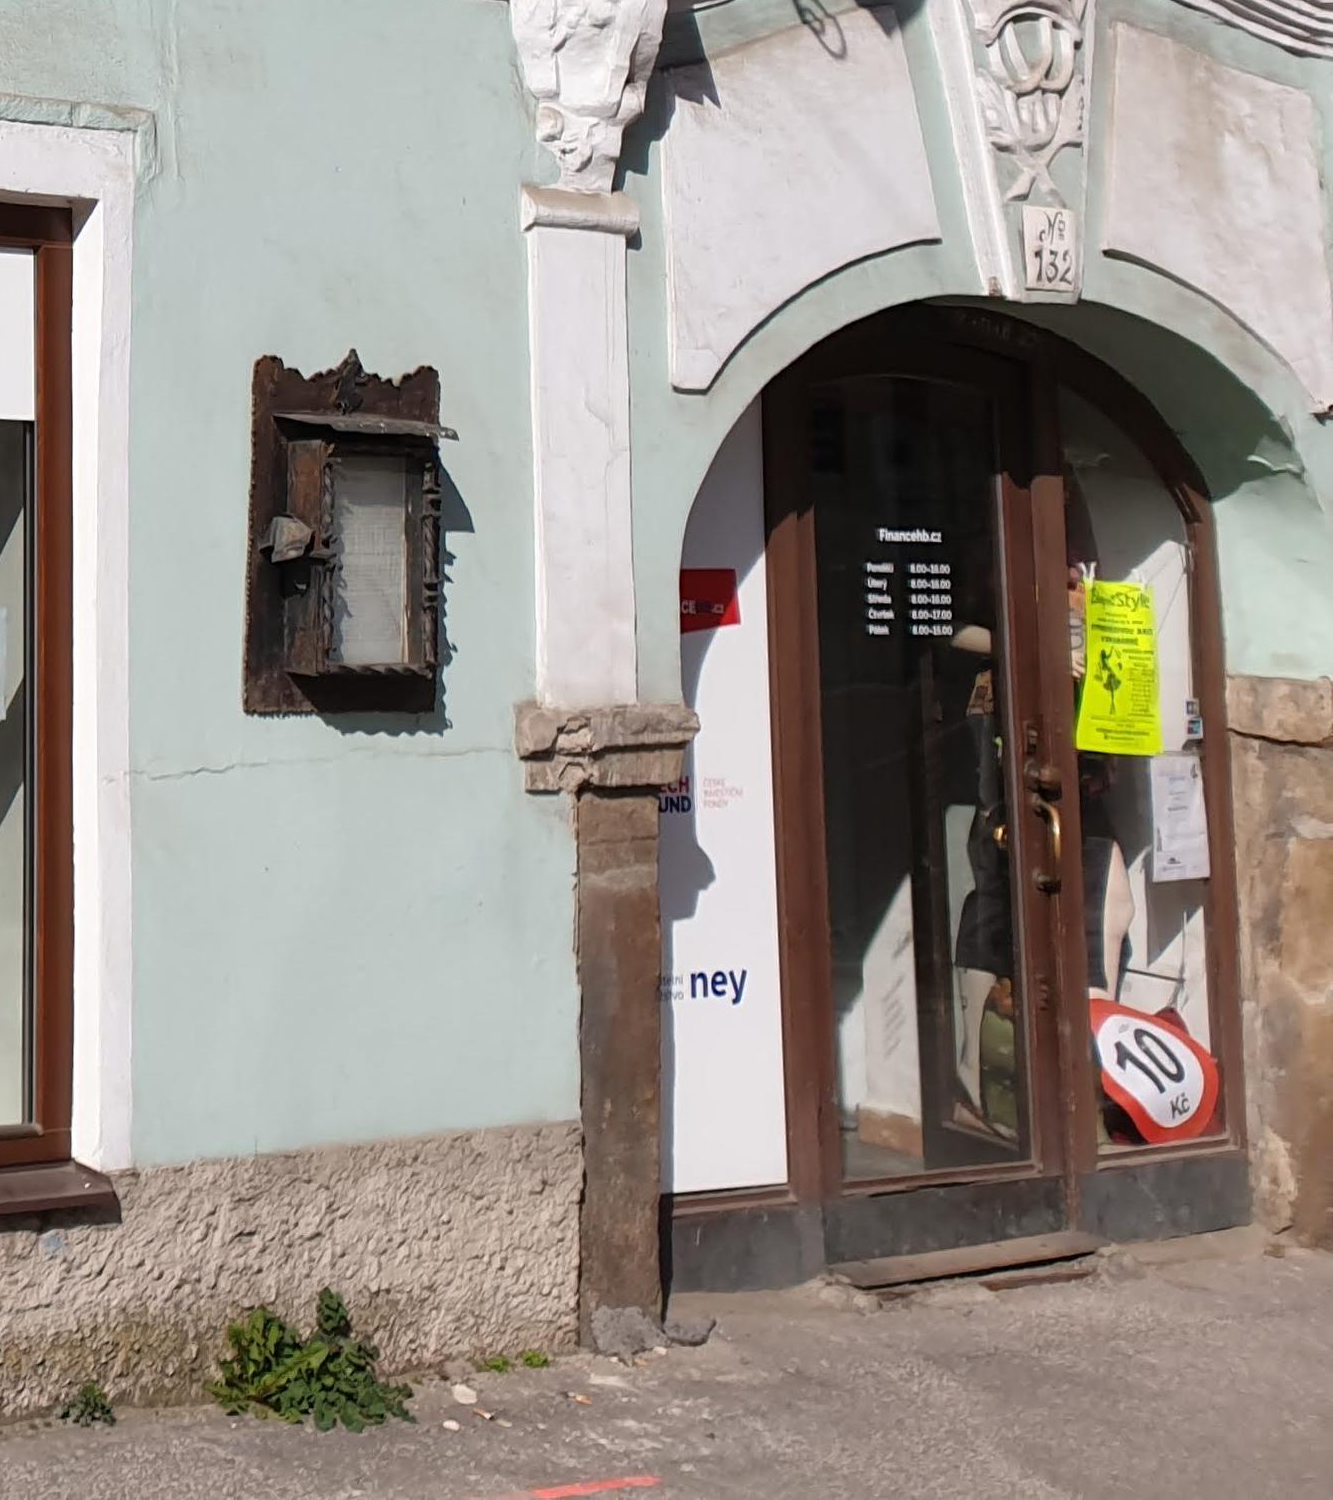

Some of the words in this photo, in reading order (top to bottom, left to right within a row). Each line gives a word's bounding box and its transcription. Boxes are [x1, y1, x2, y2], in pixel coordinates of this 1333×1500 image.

[1034, 249, 1073, 285] 132
[691, 969, 747, 1005] ney
[1114, 1028, 1185, 1094] 10
[1170, 1093, 1190, 1120] Kč
